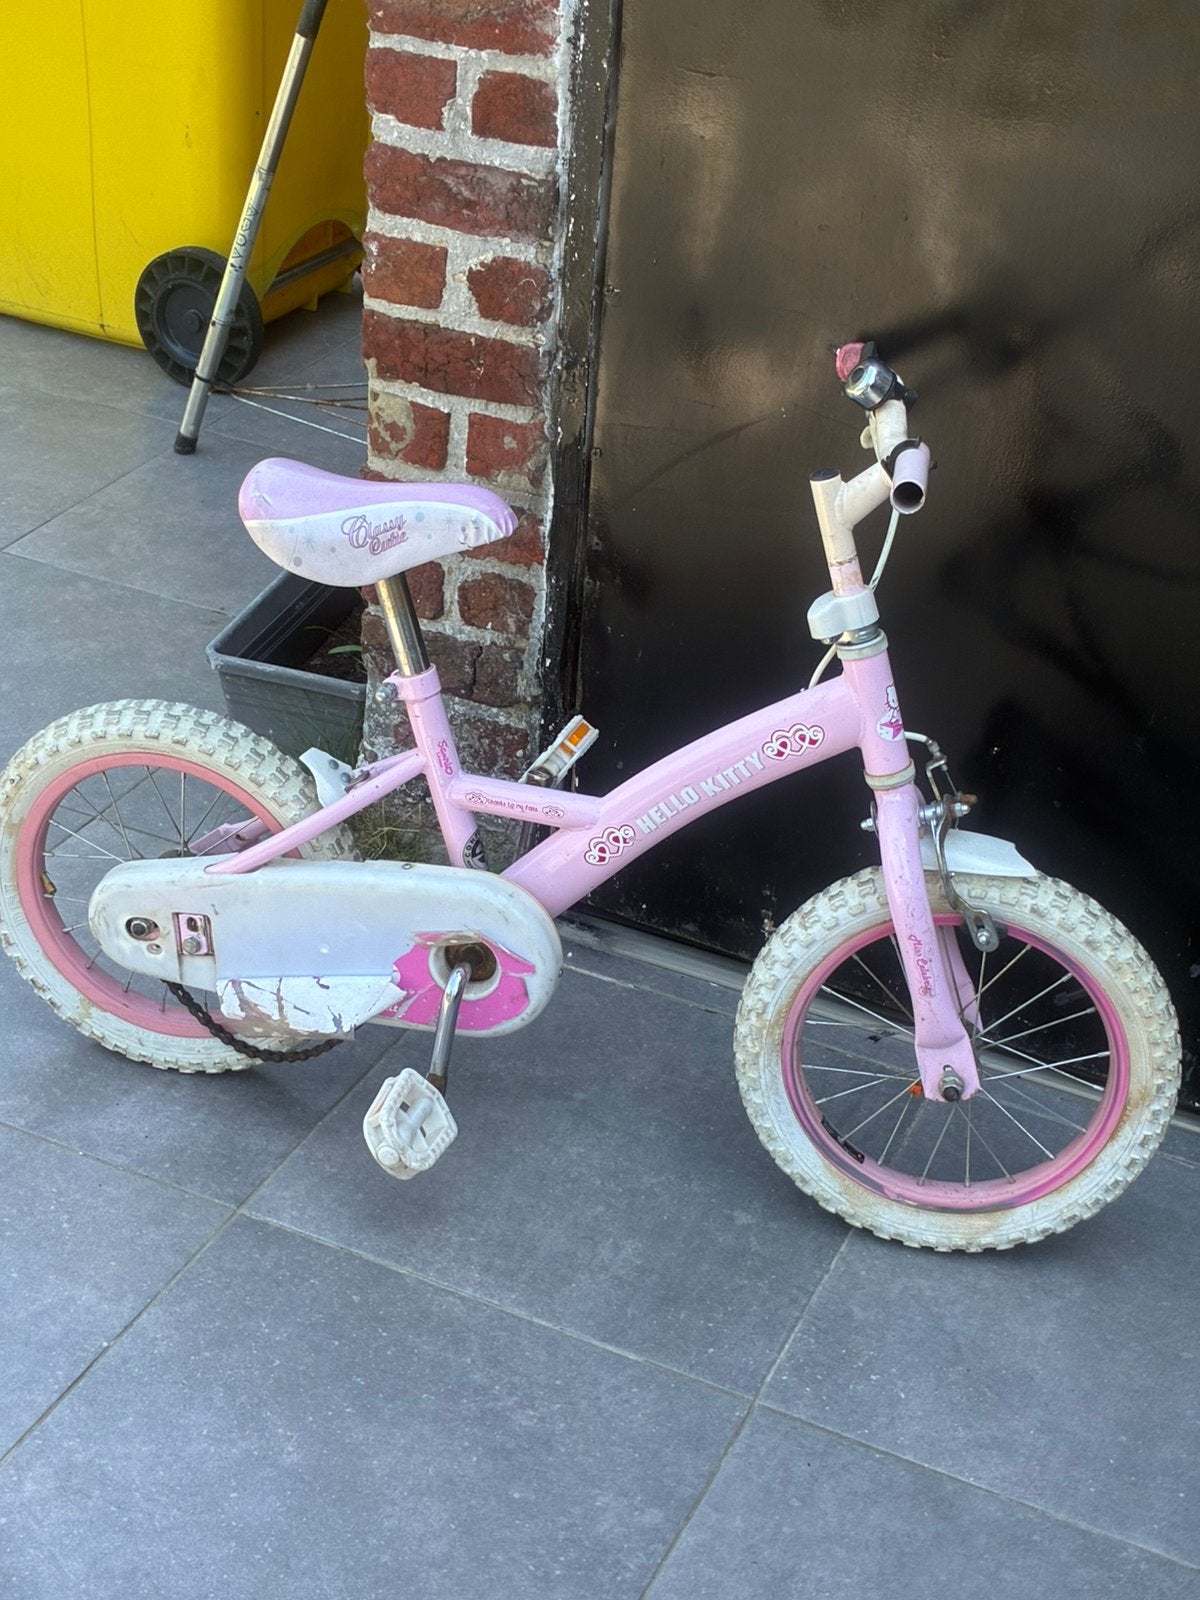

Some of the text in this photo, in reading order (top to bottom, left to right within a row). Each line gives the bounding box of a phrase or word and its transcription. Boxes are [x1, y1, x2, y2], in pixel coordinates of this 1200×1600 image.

[341, 514, 407, 548] Classy
[636, 751, 765, 834] HELLO KITTY
